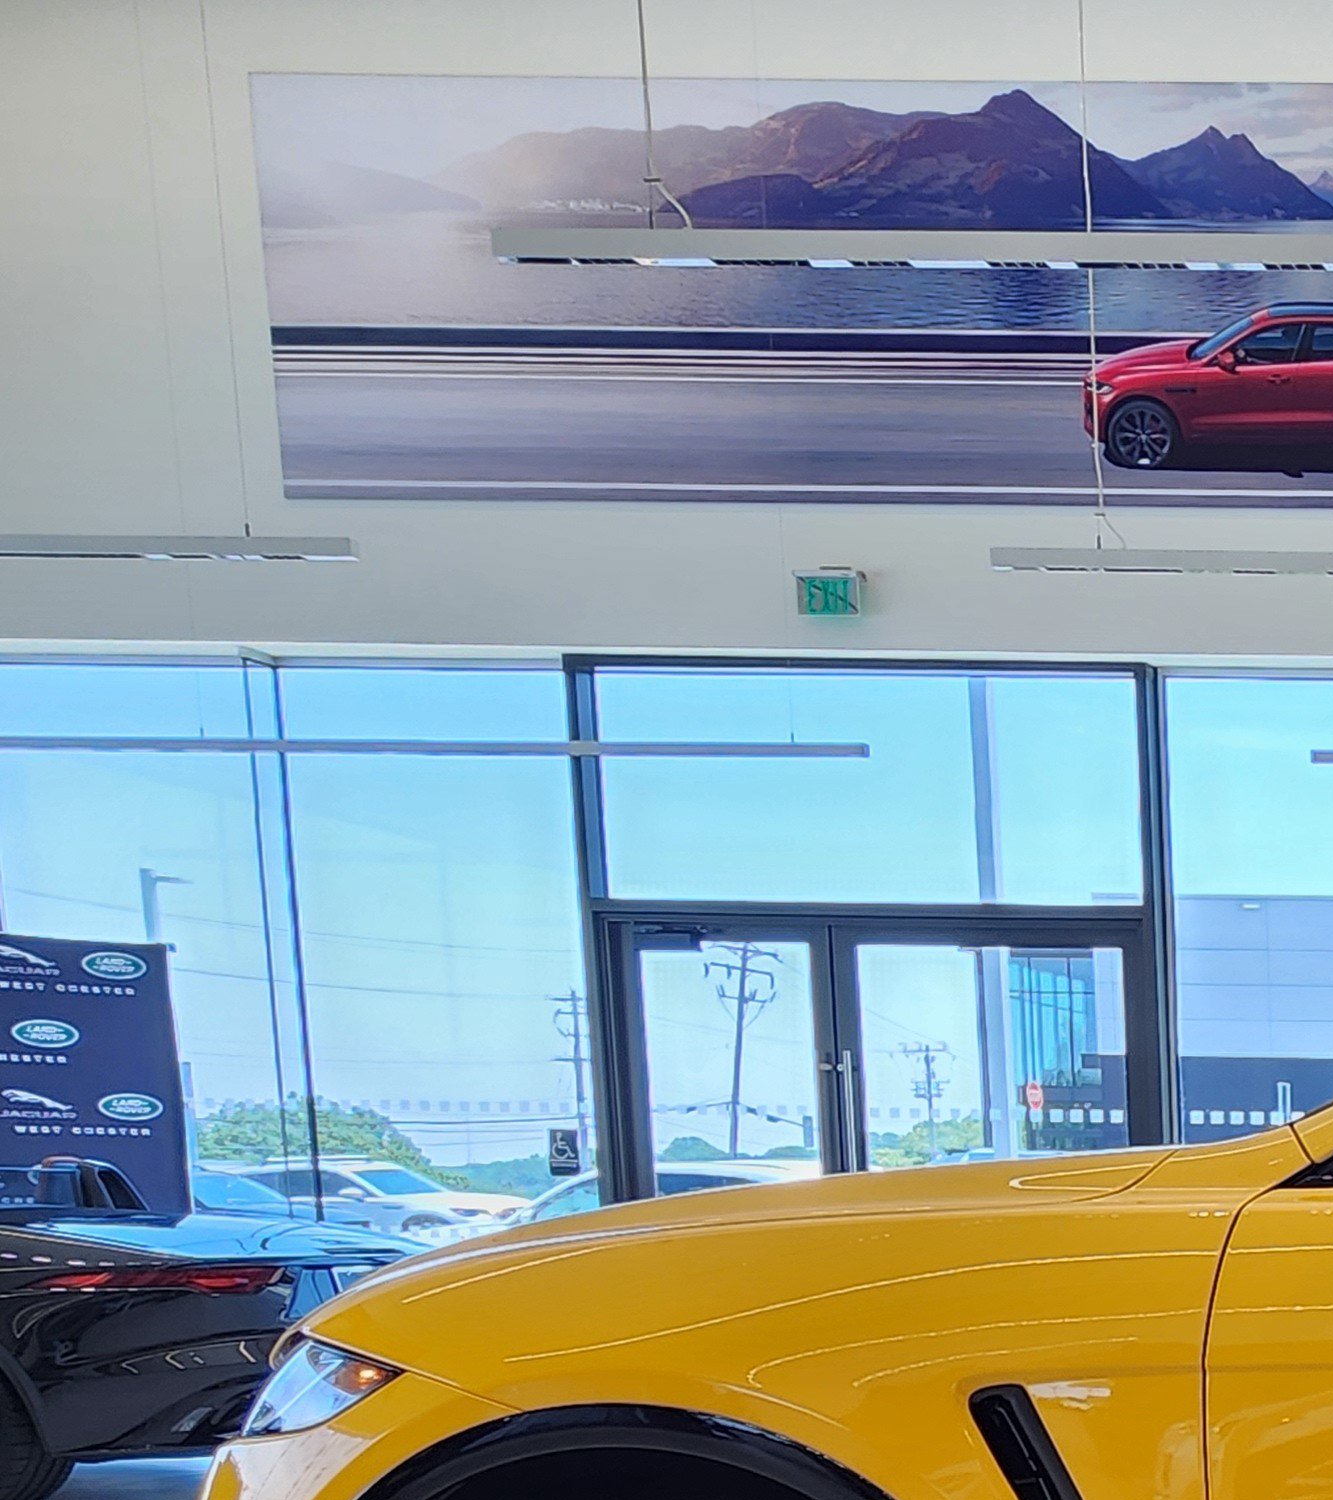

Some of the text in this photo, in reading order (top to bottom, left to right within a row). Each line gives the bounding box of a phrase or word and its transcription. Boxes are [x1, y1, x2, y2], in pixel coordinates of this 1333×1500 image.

[807, 578, 848, 613] EXIT
[95, 957, 126, 966] LAND
[98, 964, 135, 973] ROVER
[0, 980, 136, 995] WEST CHESTER
[25, 1025, 57, 1034] LAND
[29, 1032, 67, 1041] ROVER
[111, 1099, 141, 1107] LAND
[114, 1105, 152, 1114] ROVER
[14, 1125, 151, 1136] WEST CHESTER
